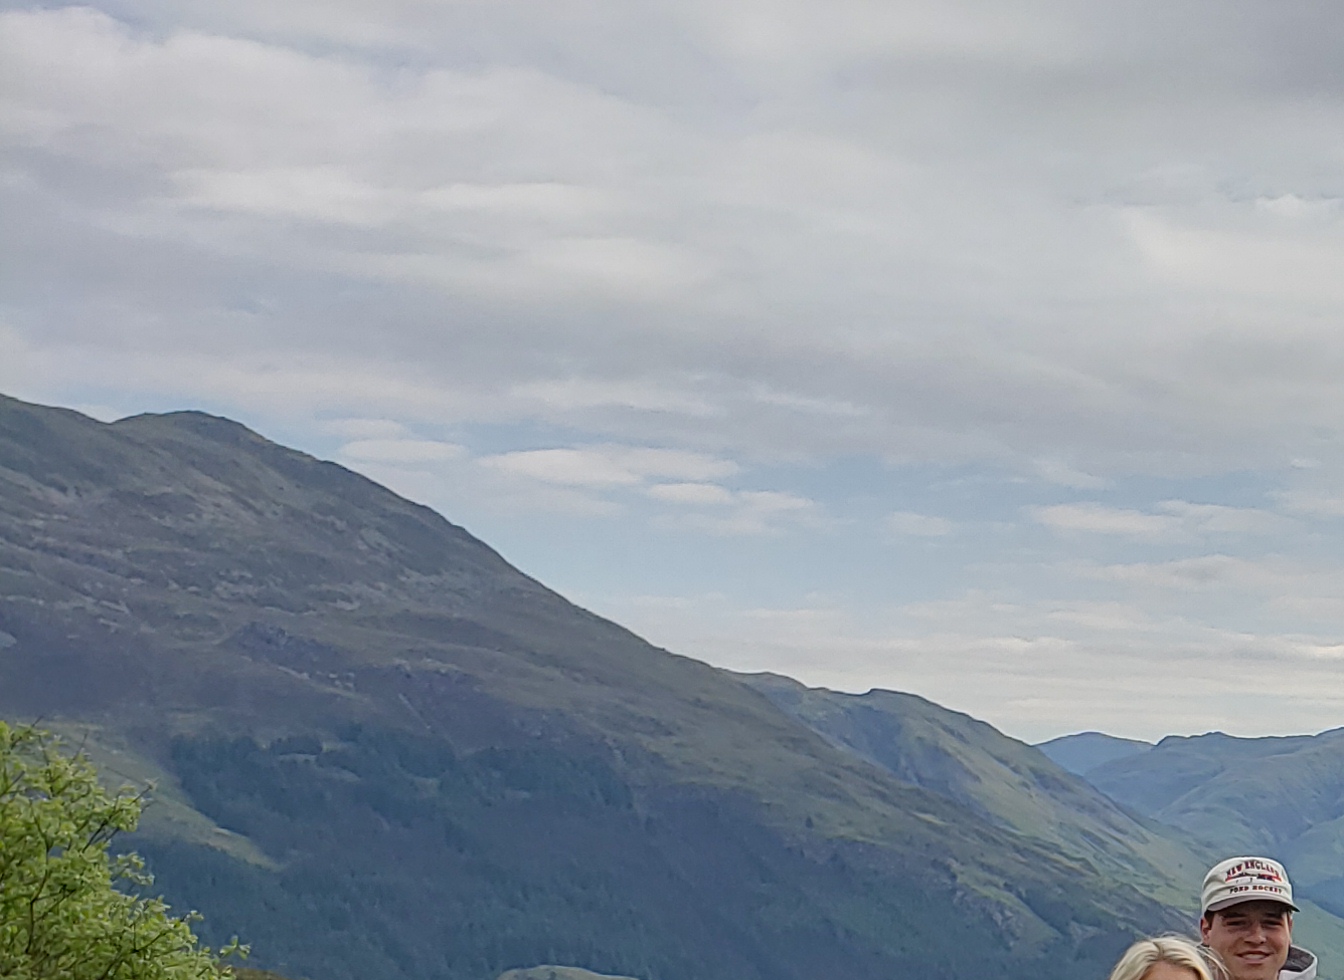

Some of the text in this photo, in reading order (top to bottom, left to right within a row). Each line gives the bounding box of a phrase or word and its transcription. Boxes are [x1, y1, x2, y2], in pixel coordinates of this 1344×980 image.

[1226, 860, 1280, 877] NEW ENGLAND
[1230, 885, 1282, 894] POND HOCKEY
